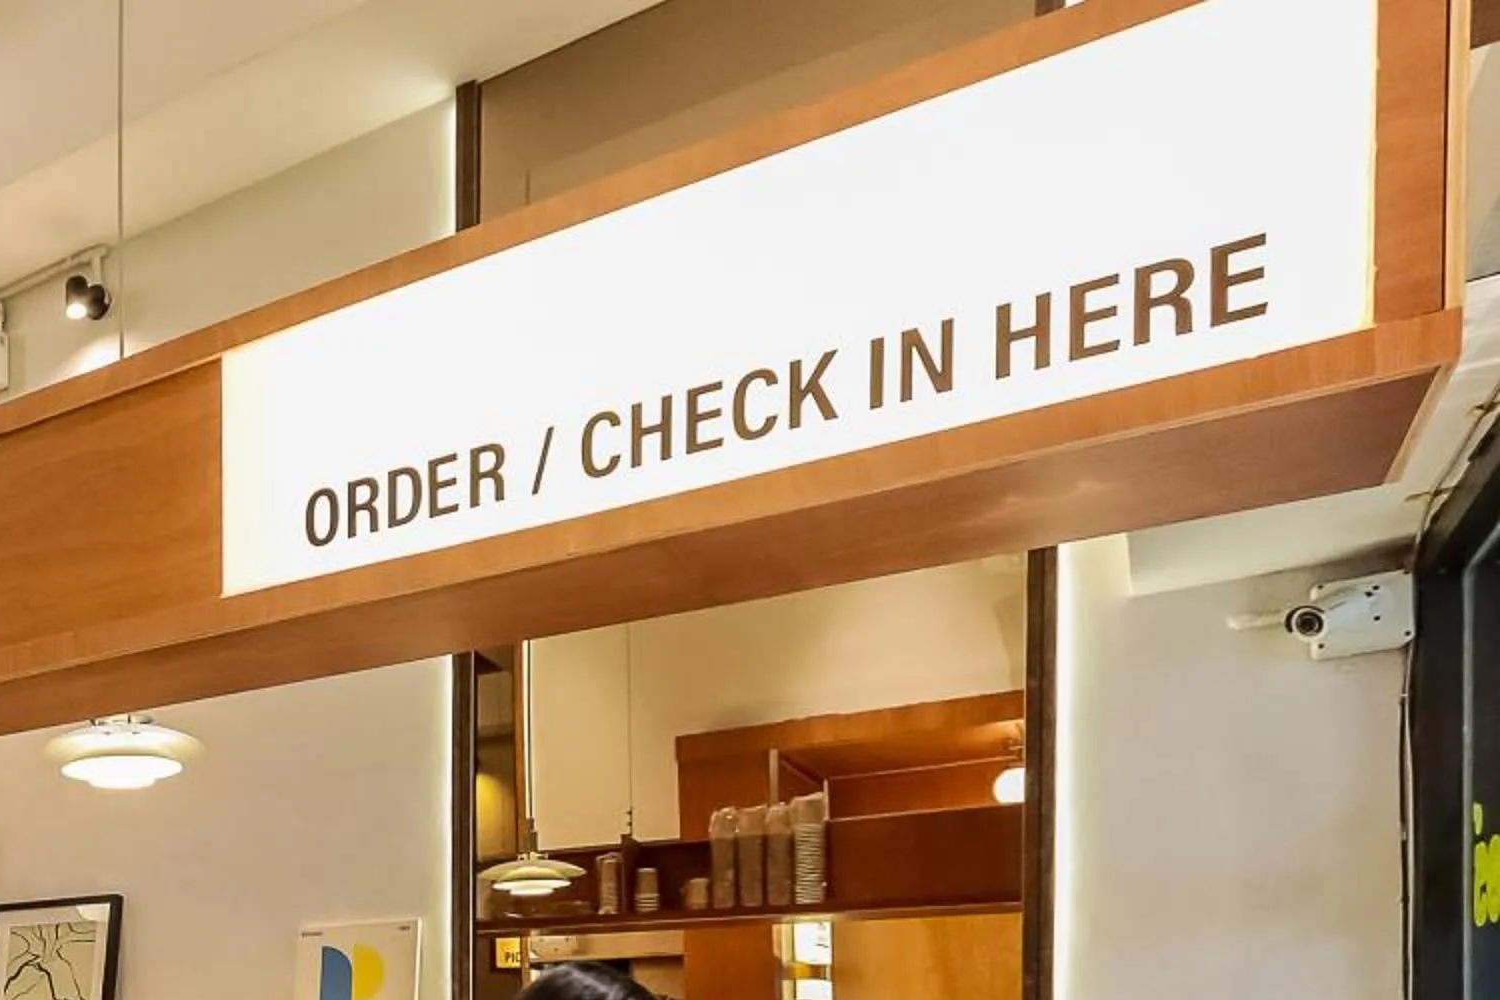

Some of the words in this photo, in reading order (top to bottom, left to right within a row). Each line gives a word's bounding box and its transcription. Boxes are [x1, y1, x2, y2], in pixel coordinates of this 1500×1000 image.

[305, 443, 505, 547] ORDER
[531, 426, 555, 496] /
[581, 350, 839, 479] CHECK
[869, 318, 954, 411] IN
[995, 232, 1269, 381] HERE
